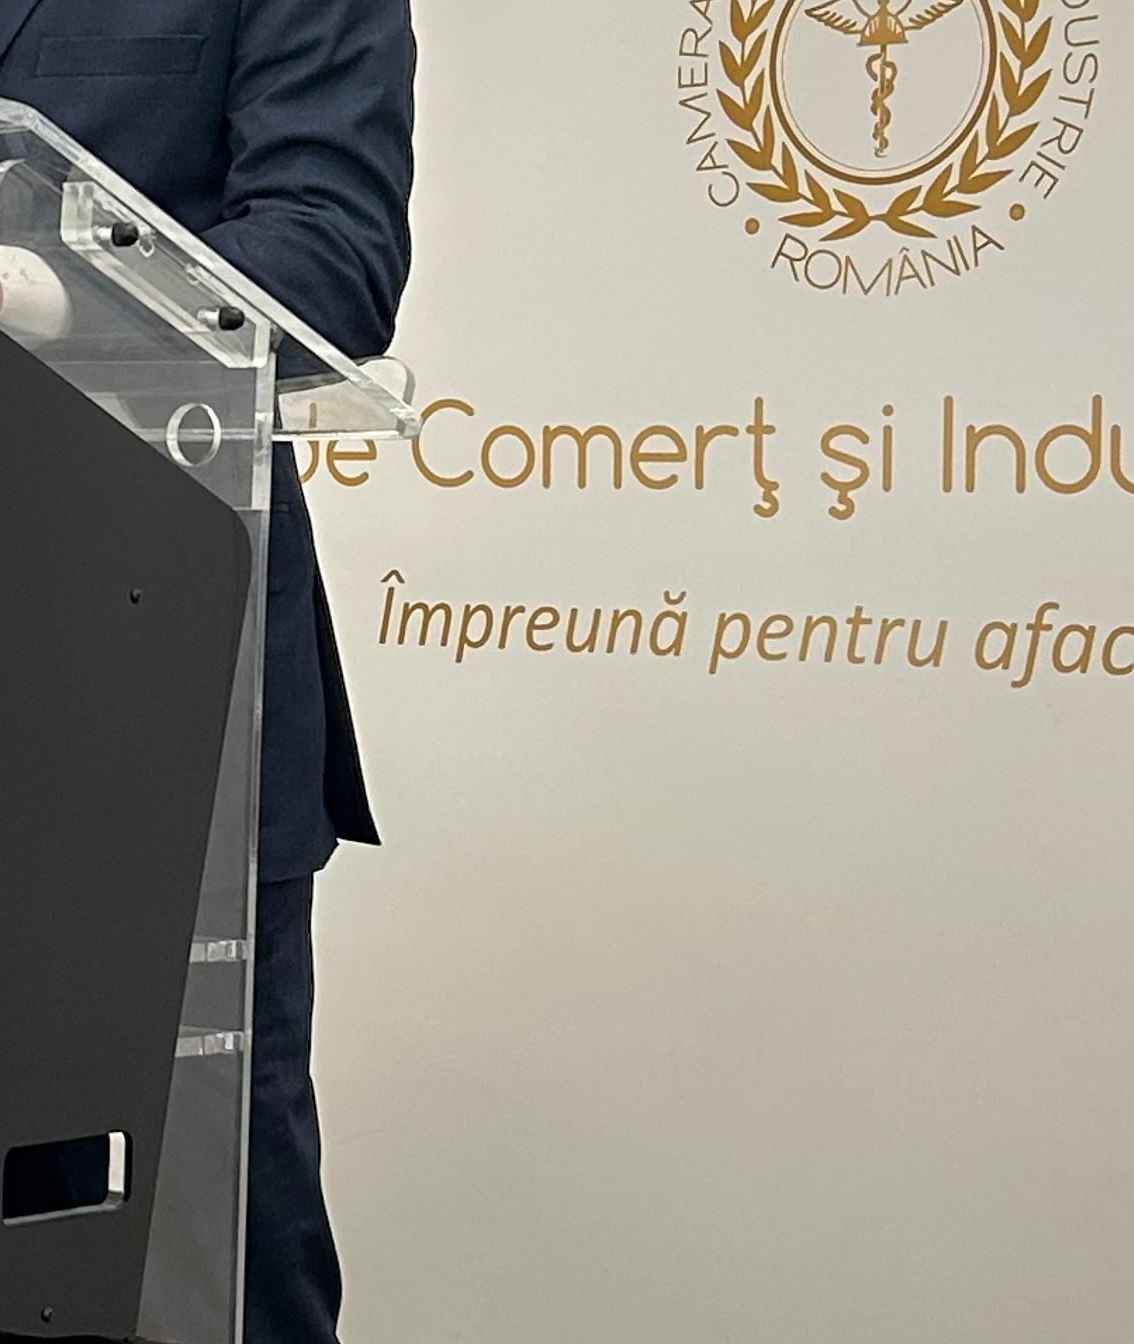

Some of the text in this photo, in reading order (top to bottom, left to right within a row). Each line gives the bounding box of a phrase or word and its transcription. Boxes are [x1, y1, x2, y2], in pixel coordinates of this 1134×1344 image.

[771, 224, 1004, 297] ROMÂNIA
[376, 569, 688, 663] Împreună
[708, 605, 949, 674] pentru
